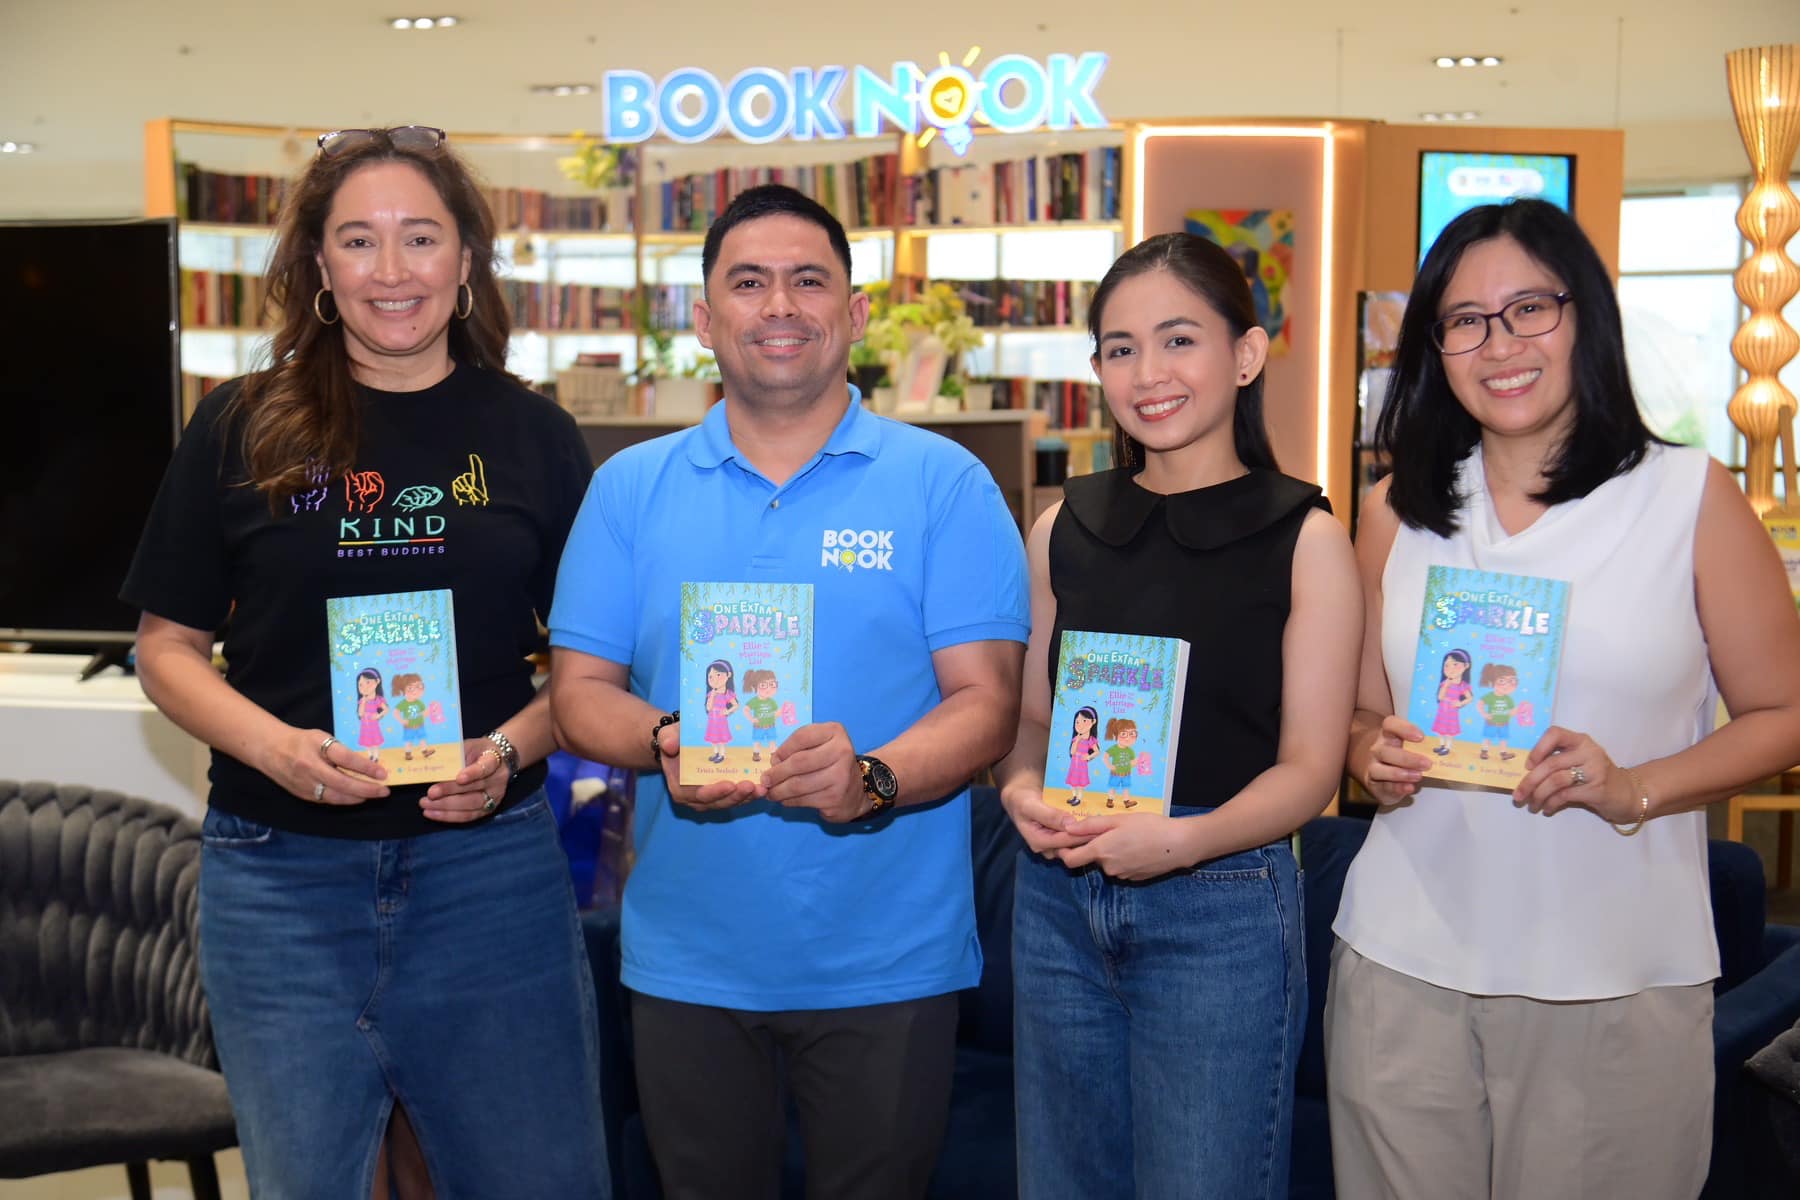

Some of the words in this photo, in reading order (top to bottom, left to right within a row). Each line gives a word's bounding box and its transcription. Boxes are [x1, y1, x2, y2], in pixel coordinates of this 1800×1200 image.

[603, 66, 848, 144] BOOK
[853, 50, 1108, 144] NOOK
[340, 515, 446, 539] KIND
[823, 528, 894, 550] BOOK
[337, 548, 374, 558] BEST
[381, 545, 445, 557] BUDDIES
[821, 547, 894, 572] NOOK
[713, 602, 738, 615] ONE
[740, 600, 773, 616] EXTRA
[1459, 591, 1485, 603] ONE
[359, 611, 383, 625] ONE
[692, 611, 801, 643] SPARKLE
[1435, 596, 1551, 636] SPARKLE
[1086, 653, 1110, 664] ONE
[1111, 651, 1141, 667] EXTRA
[1067, 658, 1165, 692] SPARKLE
